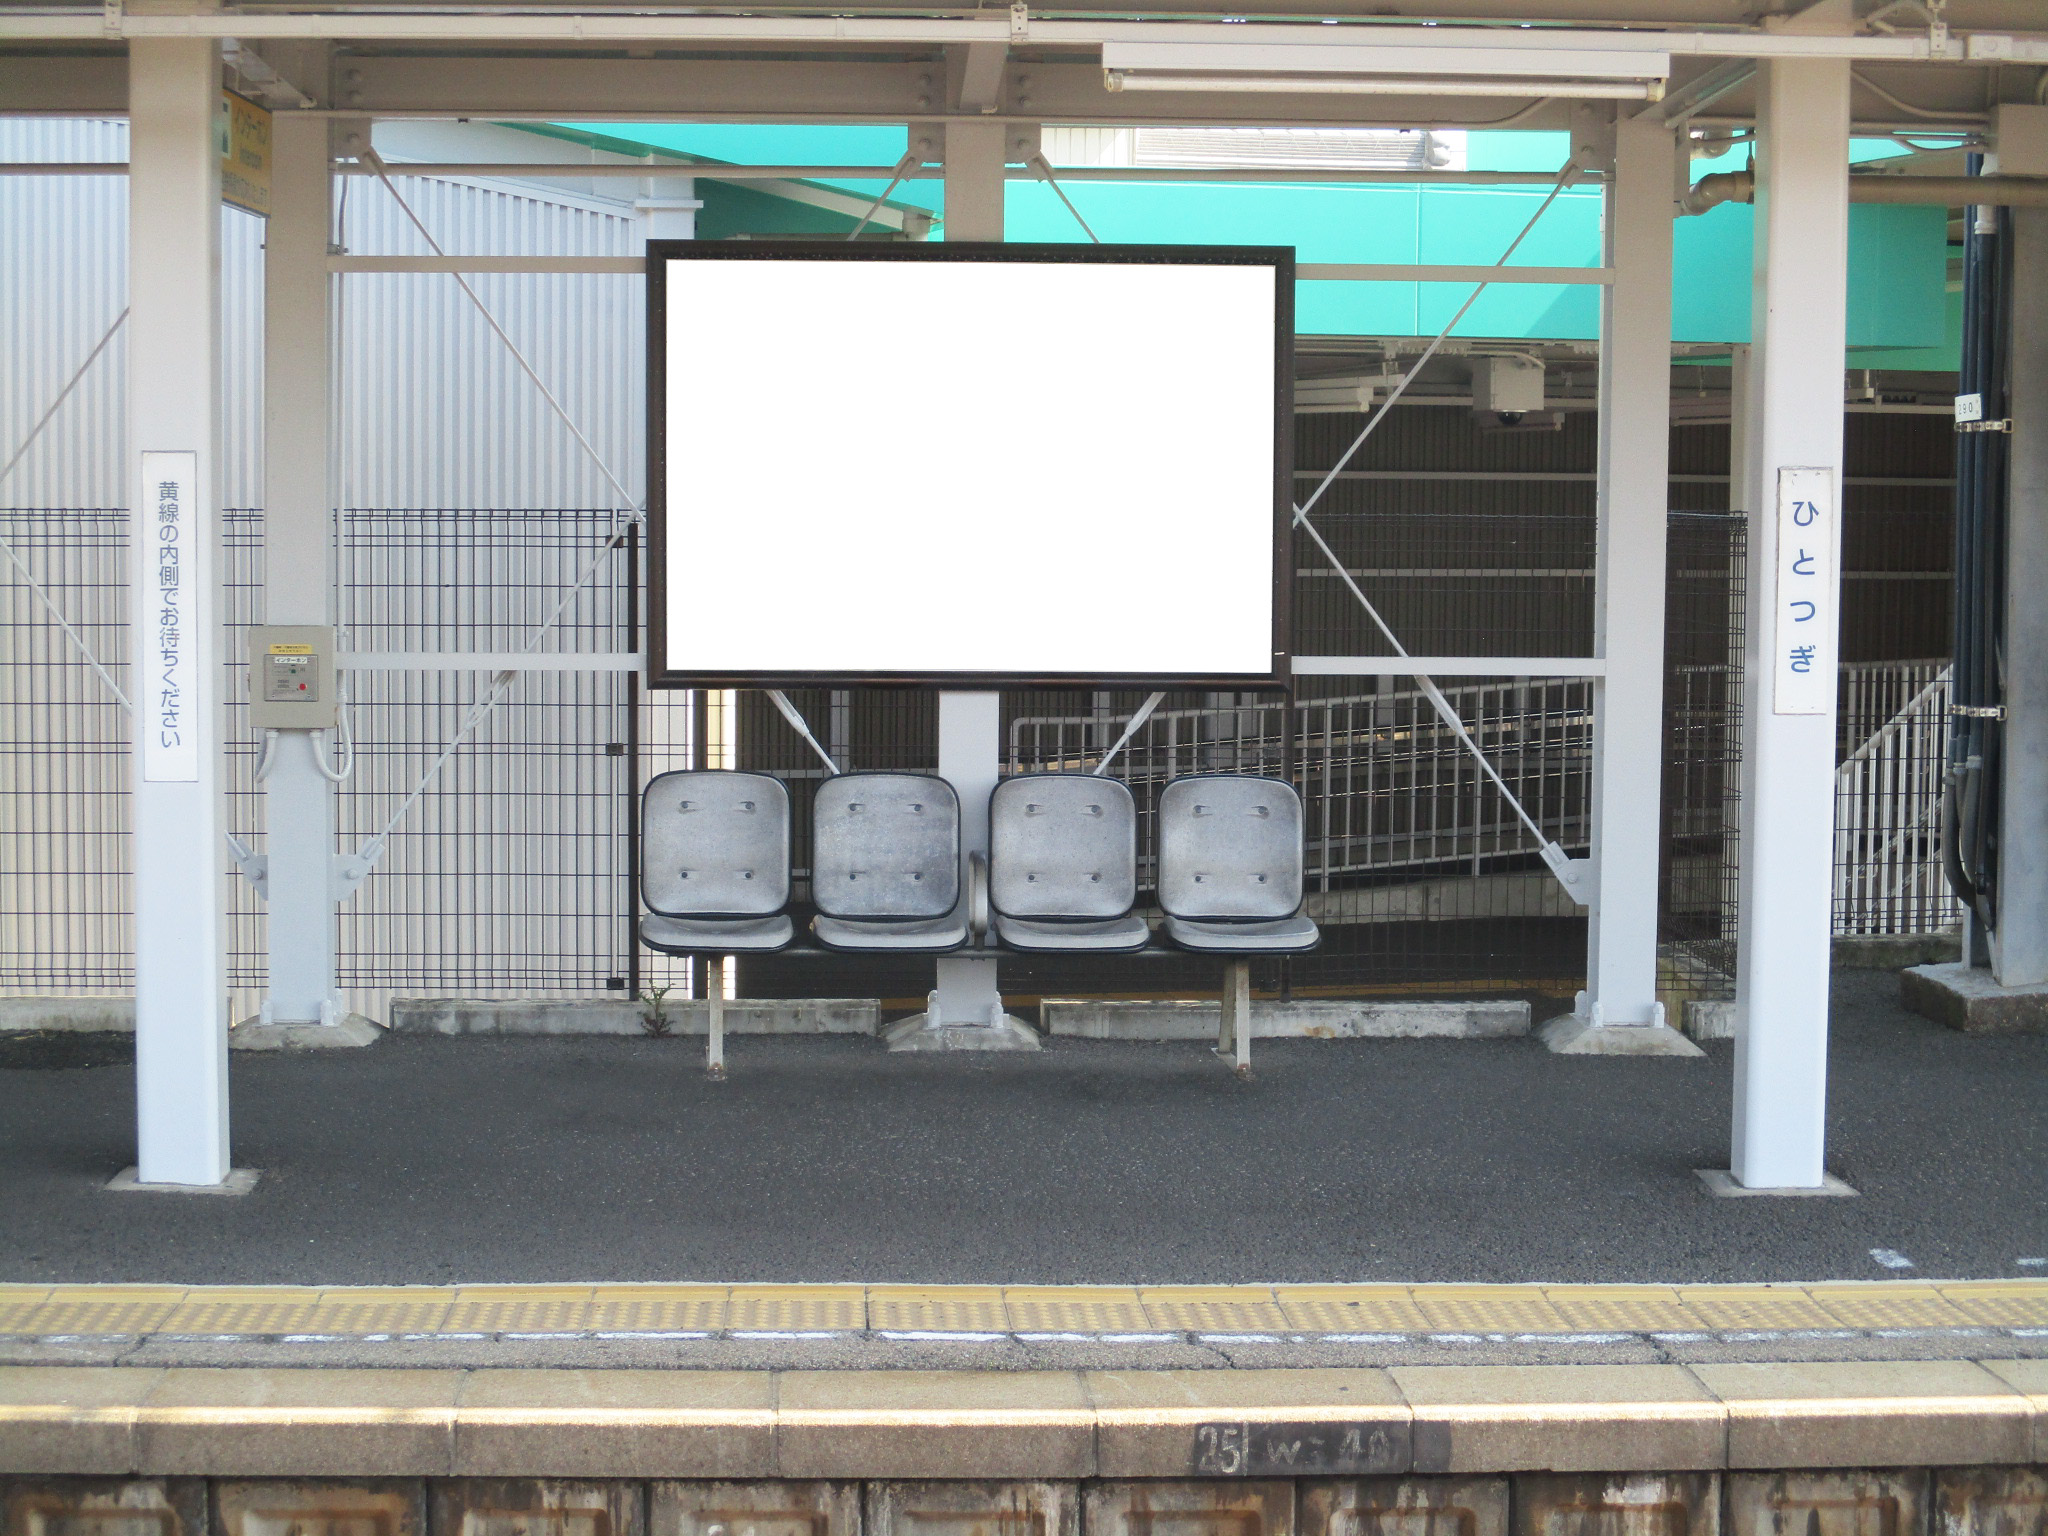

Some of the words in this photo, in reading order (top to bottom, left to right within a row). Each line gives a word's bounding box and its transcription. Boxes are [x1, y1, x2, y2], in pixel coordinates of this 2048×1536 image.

[1957, 401, 1974, 416] 290
[158, 480, 181, 748] 黄線の内側でお待ちください
[1789, 500, 1820, 673] ひとつぎ
[1198, 1425, 1241, 1474] 25
